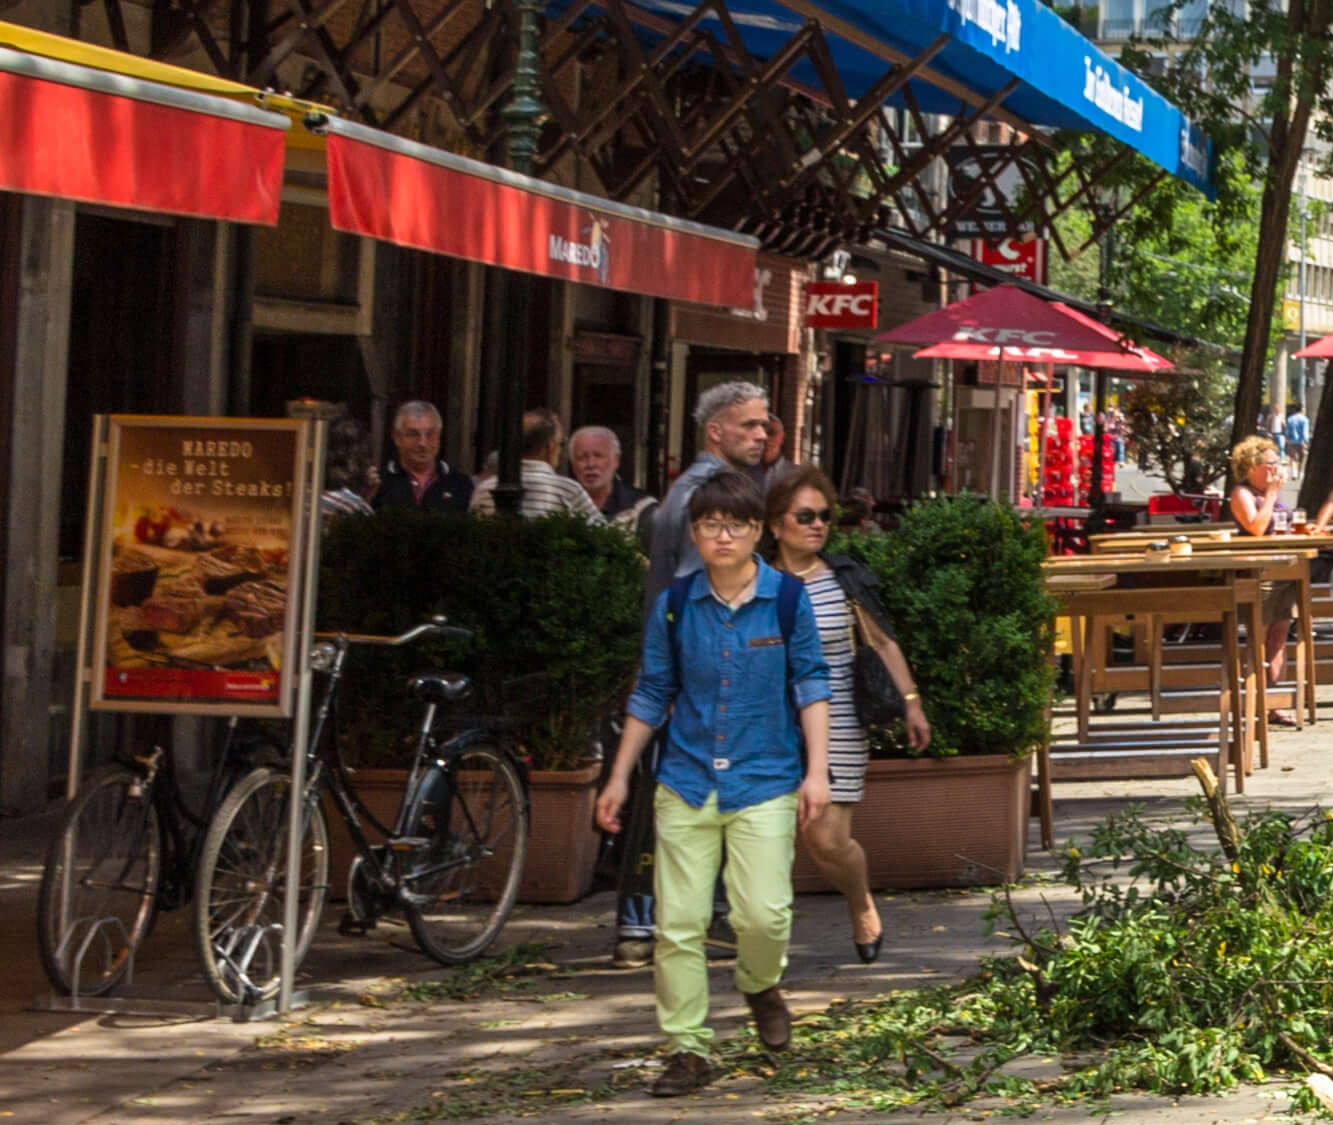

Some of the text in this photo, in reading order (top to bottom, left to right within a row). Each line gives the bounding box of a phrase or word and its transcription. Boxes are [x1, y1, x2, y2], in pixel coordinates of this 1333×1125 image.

[806, 293, 874, 316] KFC
[953, 326, 1056, 345] KFC
[182, 440, 254, 458] MAREDO
[171, 479, 206, 495] der
